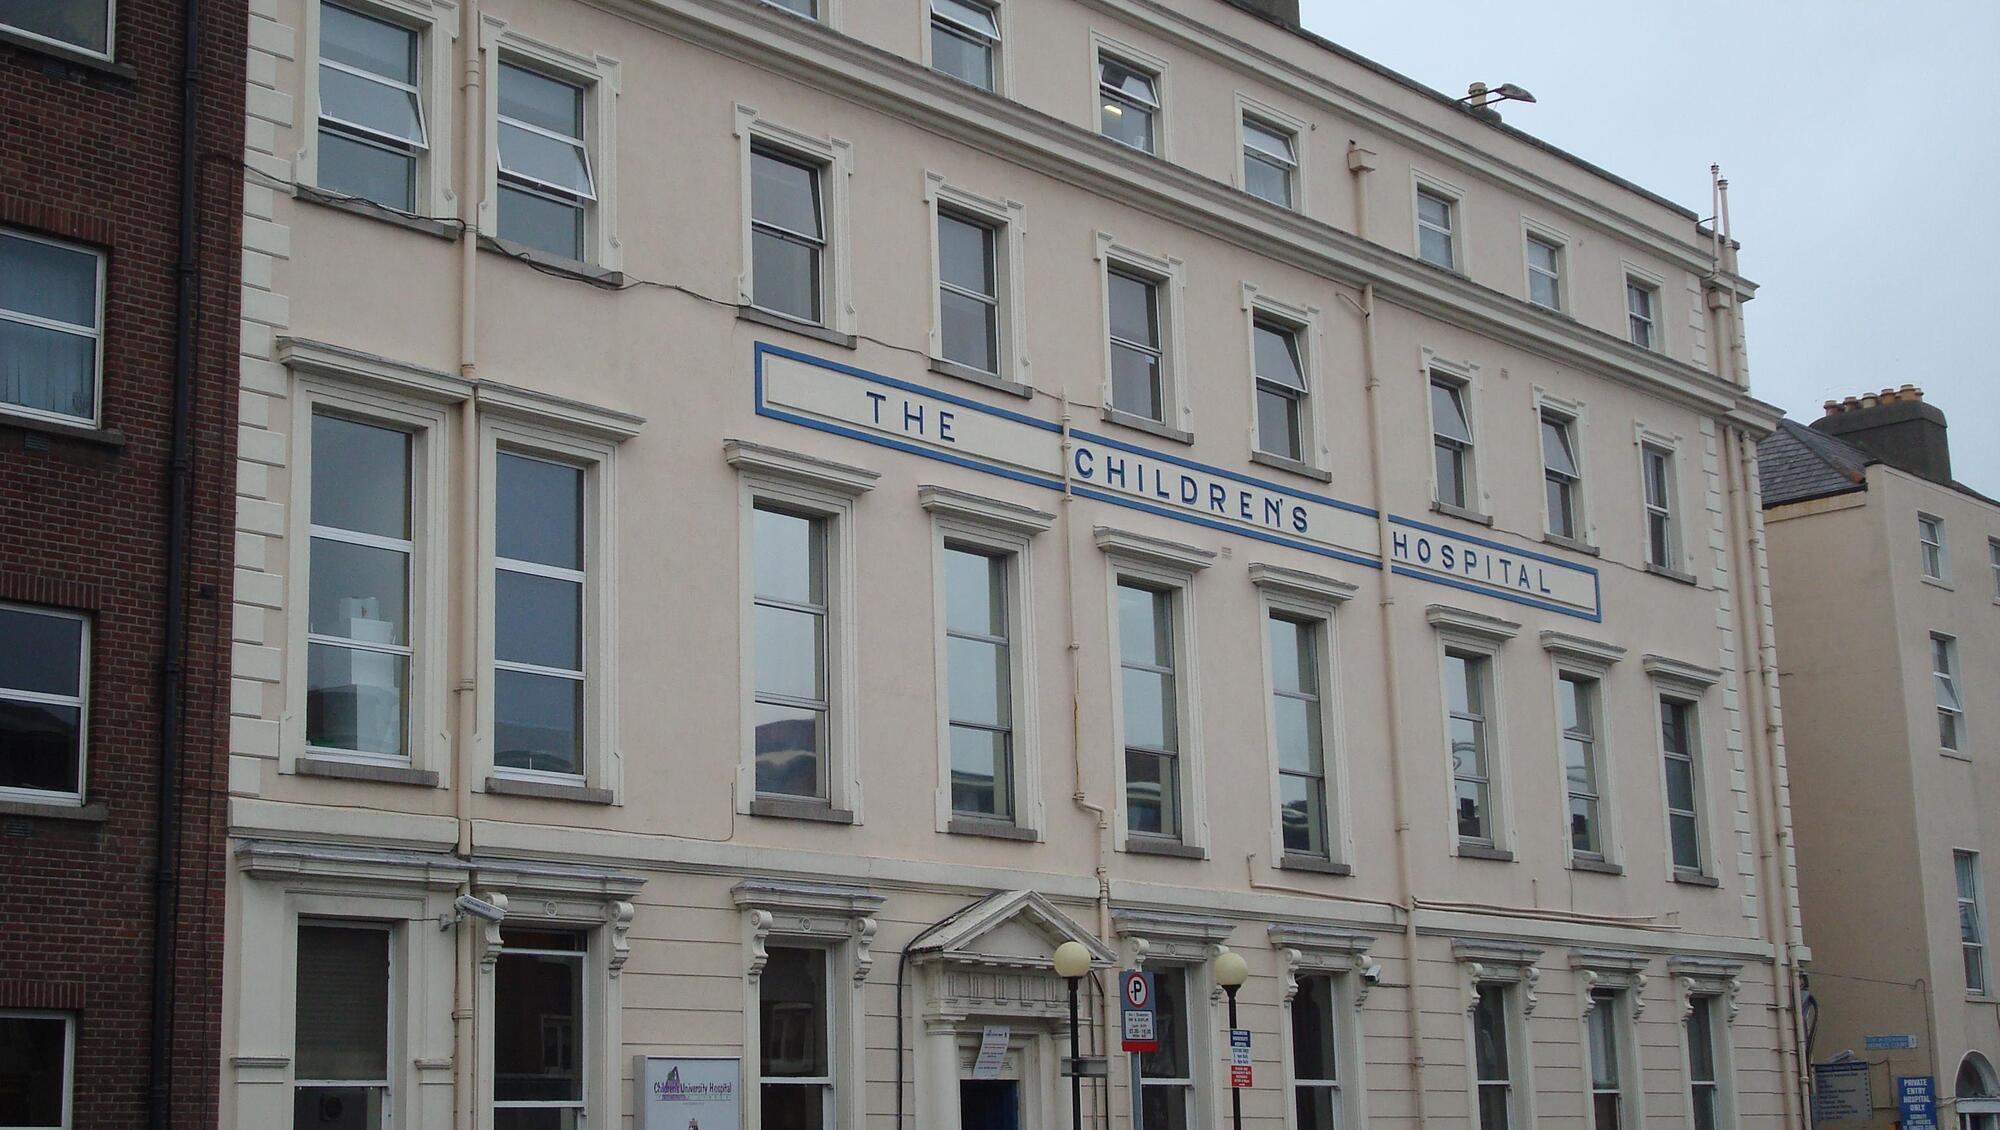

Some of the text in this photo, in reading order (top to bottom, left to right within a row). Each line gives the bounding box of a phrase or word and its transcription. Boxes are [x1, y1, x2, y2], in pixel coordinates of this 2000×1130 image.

[866, 391, 1551, 594] THE CHILDREN'S HOSPITAL
[1133, 980, 1142, 1001] P
[1903, 1079, 1928, 1087] PRIVATE
[680, 1082, 708, 1095] University
[709, 1082, 732, 1095] Hospital
[1906, 1087, 1926, 1095] ENTRY
[1903, 1095, 1930, 1103] HOSPITAL
